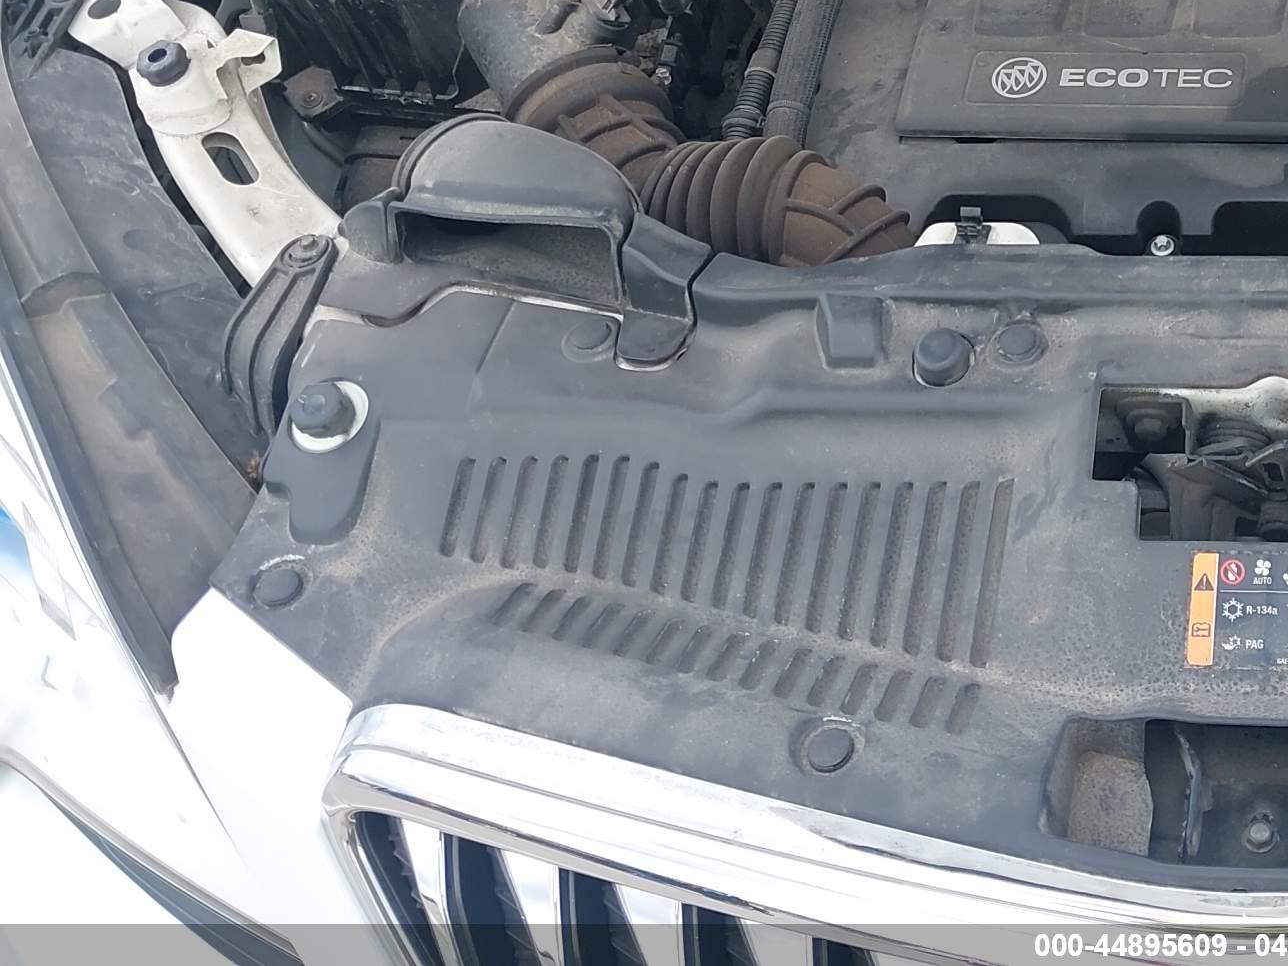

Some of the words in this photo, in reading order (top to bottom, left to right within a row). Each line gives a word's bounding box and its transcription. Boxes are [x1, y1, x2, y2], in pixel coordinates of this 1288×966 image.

[1059, 68, 1233, 88] ECOTEC
[1253, 577, 1272, 585] AUTO
[1246, 605, 1278, 616] R-134a
[1245, 639, 1264, 650] PAG
